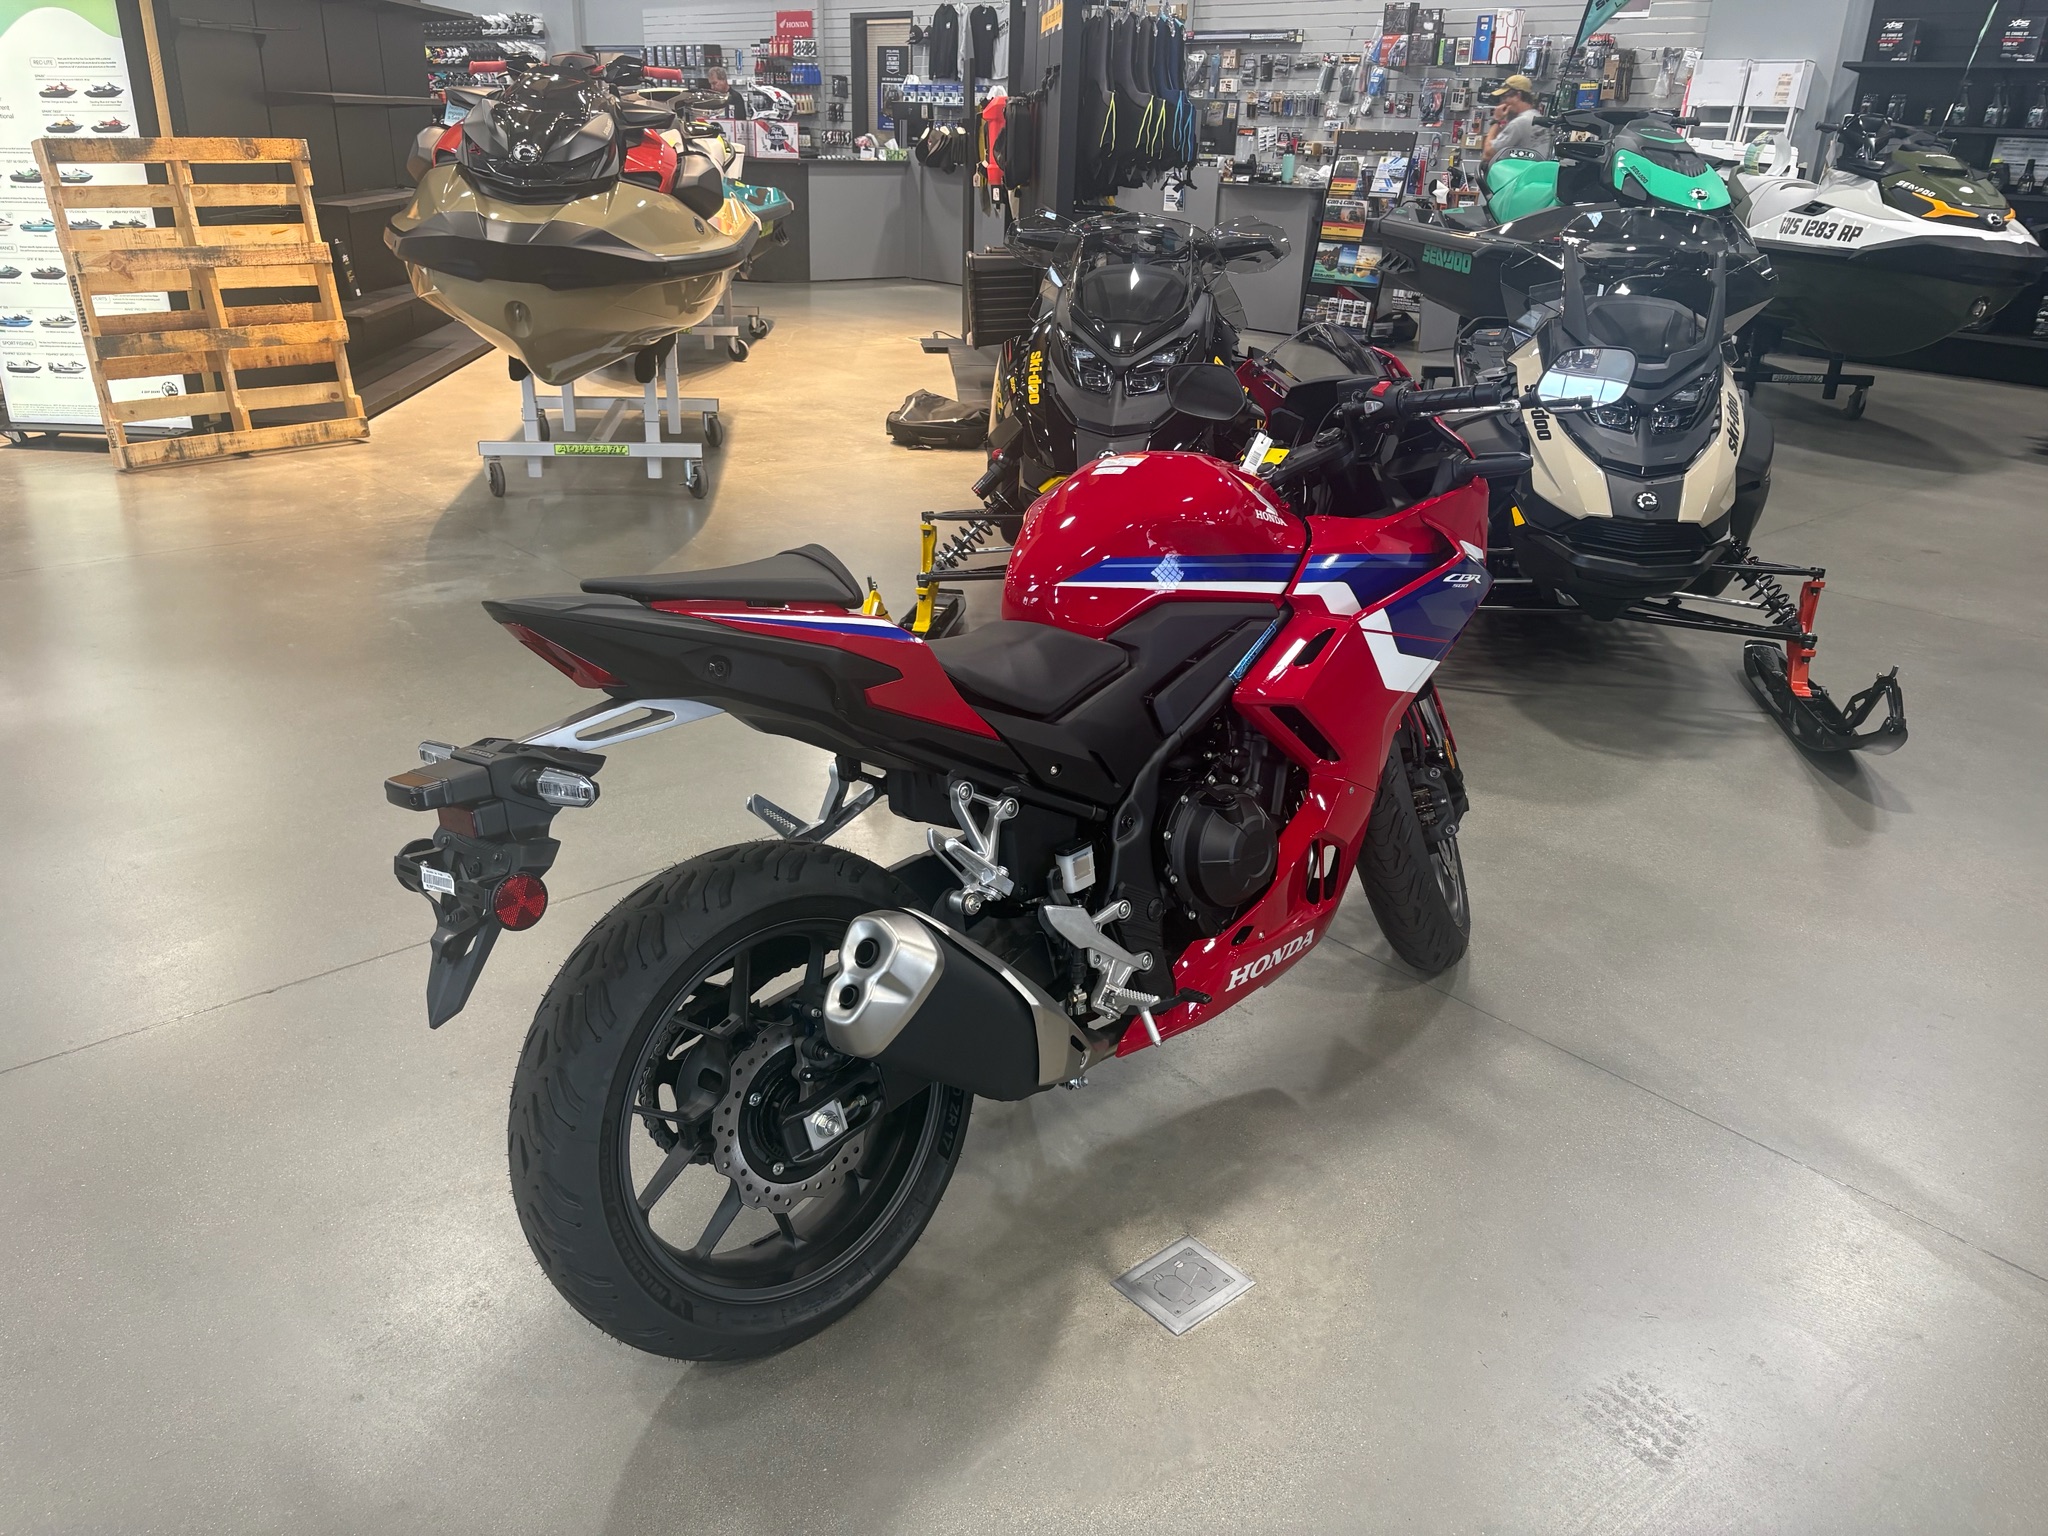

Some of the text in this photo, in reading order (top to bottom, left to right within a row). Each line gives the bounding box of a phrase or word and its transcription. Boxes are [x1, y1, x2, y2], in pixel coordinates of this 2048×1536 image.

[786, 20, 809, 28] HONDA
[1883, 21, 1905, 30] XPS
[2008, 18, 2032, 27] XPS
[1801, 219, 1839, 240] 1283
[1028, 350, 1043, 405] ski-doo
[1727, 391, 1739, 458] ski-doo
[1254, 508, 1288, 527] HONDA
[1442, 573, 1482, 585] CBR
[1224, 928, 1315, 993] HONDA
[948, 1102, 960, 1126] ZR
[943, 1131, 954, 1151] 17
[610, 1216, 669, 1300] MICHELIN
